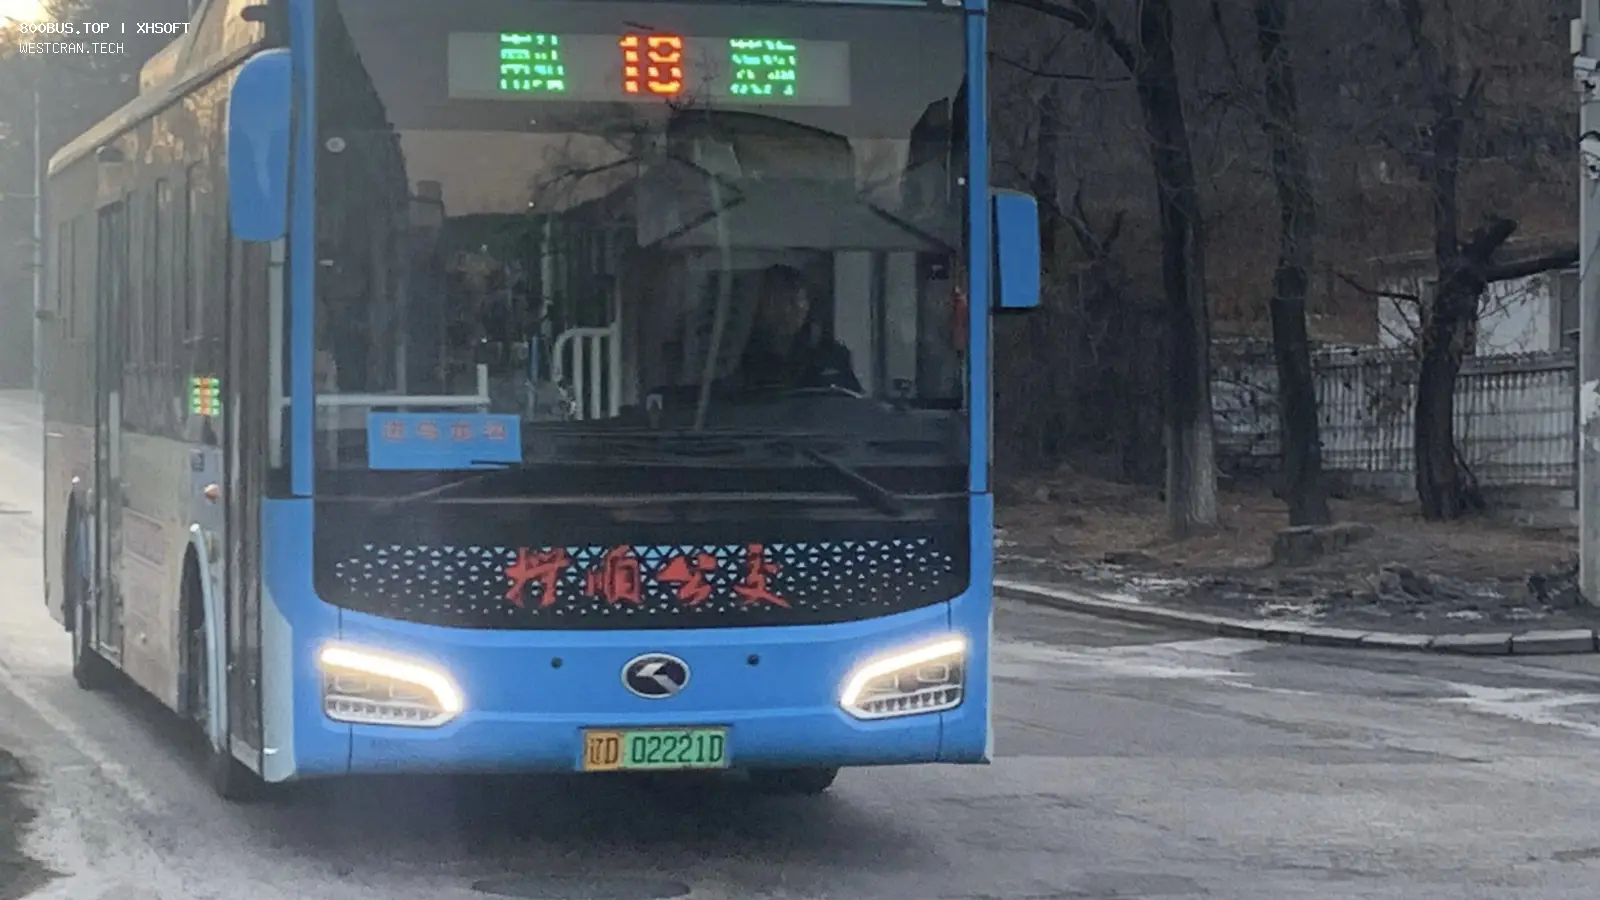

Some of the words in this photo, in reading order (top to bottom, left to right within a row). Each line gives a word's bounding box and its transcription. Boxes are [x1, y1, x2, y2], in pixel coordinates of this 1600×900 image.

[620, 35, 683, 94] 18
[504, 543, 792, 608] 抚顺公交
[631, 734, 724, 764] 02221D
